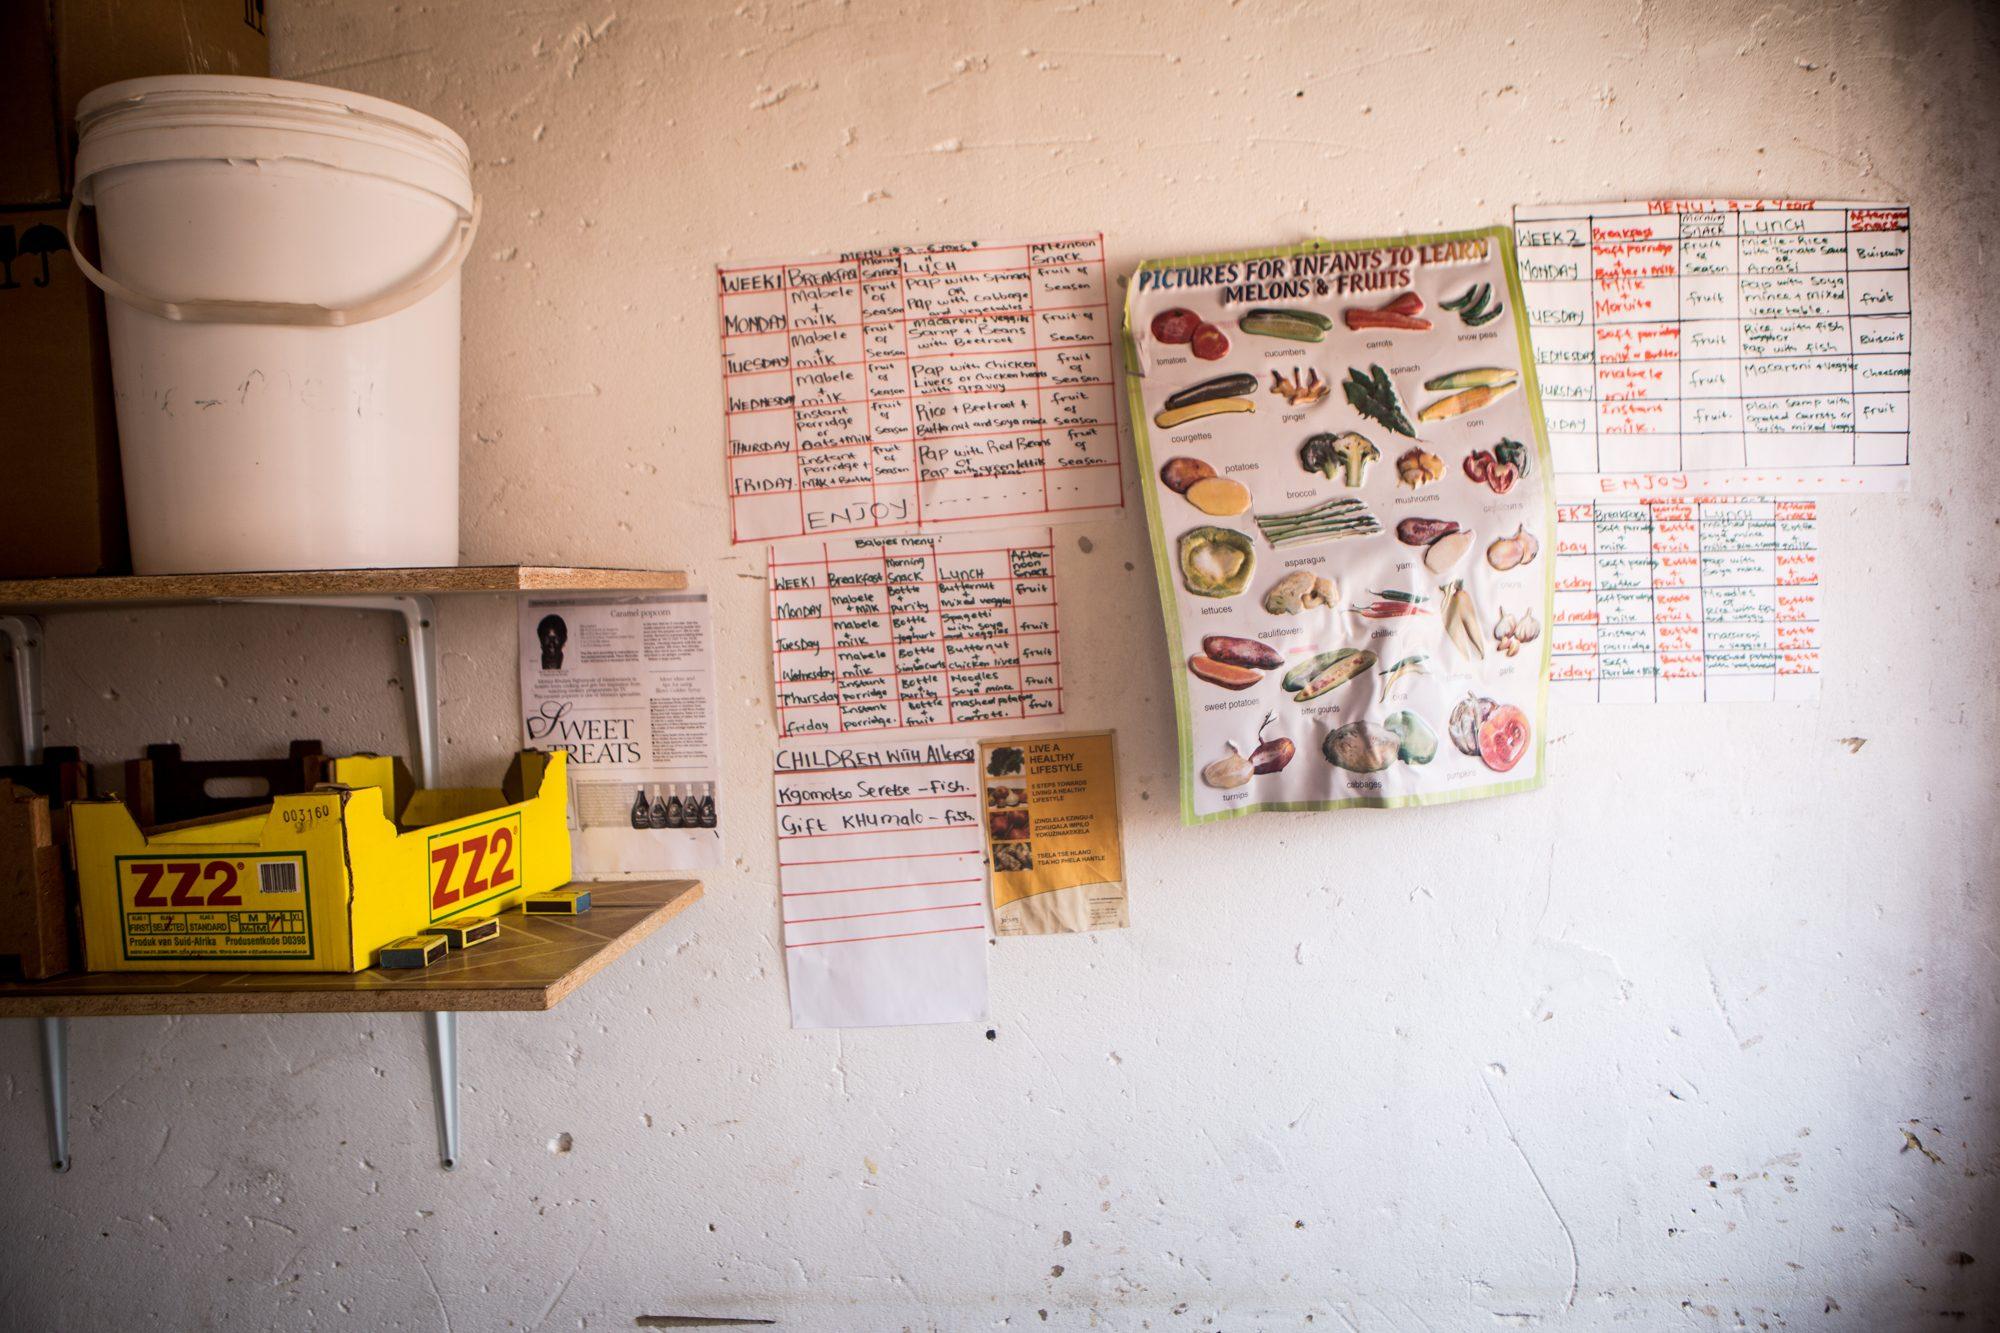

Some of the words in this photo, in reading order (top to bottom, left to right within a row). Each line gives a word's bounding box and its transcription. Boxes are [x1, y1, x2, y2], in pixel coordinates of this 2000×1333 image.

[1138, 267, 1238, 292] PICTURES
[1246, 261, 1285, 281] FOR
[1293, 249, 1382, 275] INFANTS
[1387, 248, 1414, 265] TO
[1419, 239, 1489, 266] LEARN
[1224, 280, 1310, 304] MELONS
[1316, 277, 1329, 295] &
[1337, 269, 1411, 294] FRUITS
[725, 314, 787, 335] MONDAY
[1457, 333, 1474, 341] snow
[1477, 331, 1498, 341] peas
[1366, 339, 1393, 349] carrots
[1264, 348, 1306, 358] cucumbers
[1156, 355, 1187, 365] tomatoes
[1390, 364, 1421, 375] spinach
[1282, 411, 1306, 423] ginger
[1467, 419, 1483, 427] corn
[1171, 432, 1212, 444] courgettes
[1225, 461, 1259, 473] potatoes
[1287, 488, 1317, 499] broccoli
[1395, 494, 1440, 504] mushrooms
[808, 498, 907, 529] ENJOY
[1284, 555, 1326, 568] asparagus
[610, 608, 639, 617] Caramel
[640, 608, 671, 619] popcorn
[1201, 605, 1233, 615] lettuces
[1257, 627, 1304, 639] cauliflowers
[1371, 629, 1398, 639] chillies
[1204, 702, 1226, 712] sweet
[1228, 697, 1260, 710] potatoes
[1301, 706, 1319, 715] bitter
[1320, 705, 1340, 715] gourds
[1029, 744, 1050, 753] LIVE
[1051, 744, 1060, 752] A
[777, 750, 882, 770] CHILDREN
[887, 748, 920, 763] WITH
[1030, 753, 1075, 764] HEALTHY
[1031, 763, 1083, 774] LIFESTYLE
[1058, 779, 1087, 787] TOWARDS
[1347, 779, 1382, 790] cabbages
[779, 787, 852, 805] Kgomotso
[857, 781, 910, 797] Seretse
[1032, 789, 1051, 797] LIVING
[1223, 791, 1248, 802] turnips
[1033, 795, 1064, 803] LIFESTYLE
[283, 805, 330, 823] 003160
[782, 815, 828, 835] Gift
[432, 827, 514, 911] ZZ2
[131, 861, 242, 907] ZZ2
[230, 914, 239, 922] S
[249, 914, 258, 922] M
[293, 913, 303, 921] XL
[129, 924, 149, 932] FIRST
[189, 923, 227, 931] STANDARD
[130, 937, 155, 946] Produk
[159, 938, 172, 946] van
[174, 937, 216, 946] Suid-Afrika
[225, 936, 280, 945] Produsentkode
